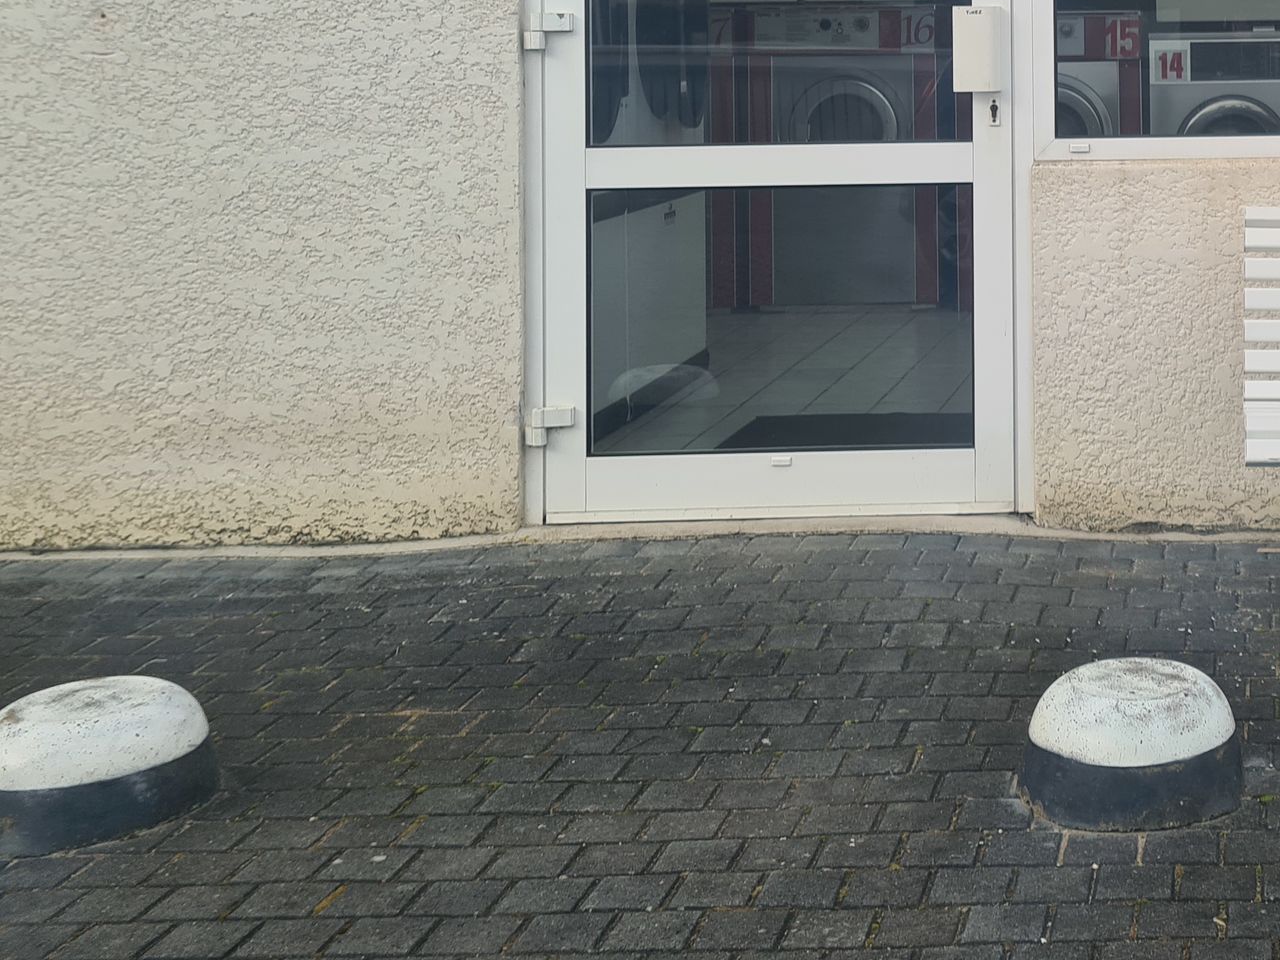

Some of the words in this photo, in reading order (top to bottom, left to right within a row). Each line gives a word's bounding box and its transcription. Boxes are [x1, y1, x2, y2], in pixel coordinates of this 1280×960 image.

[902, 13, 934, 46] 16
[1105, 19, 1141, 57] 15
[1159, 51, 1184, 79] 14
